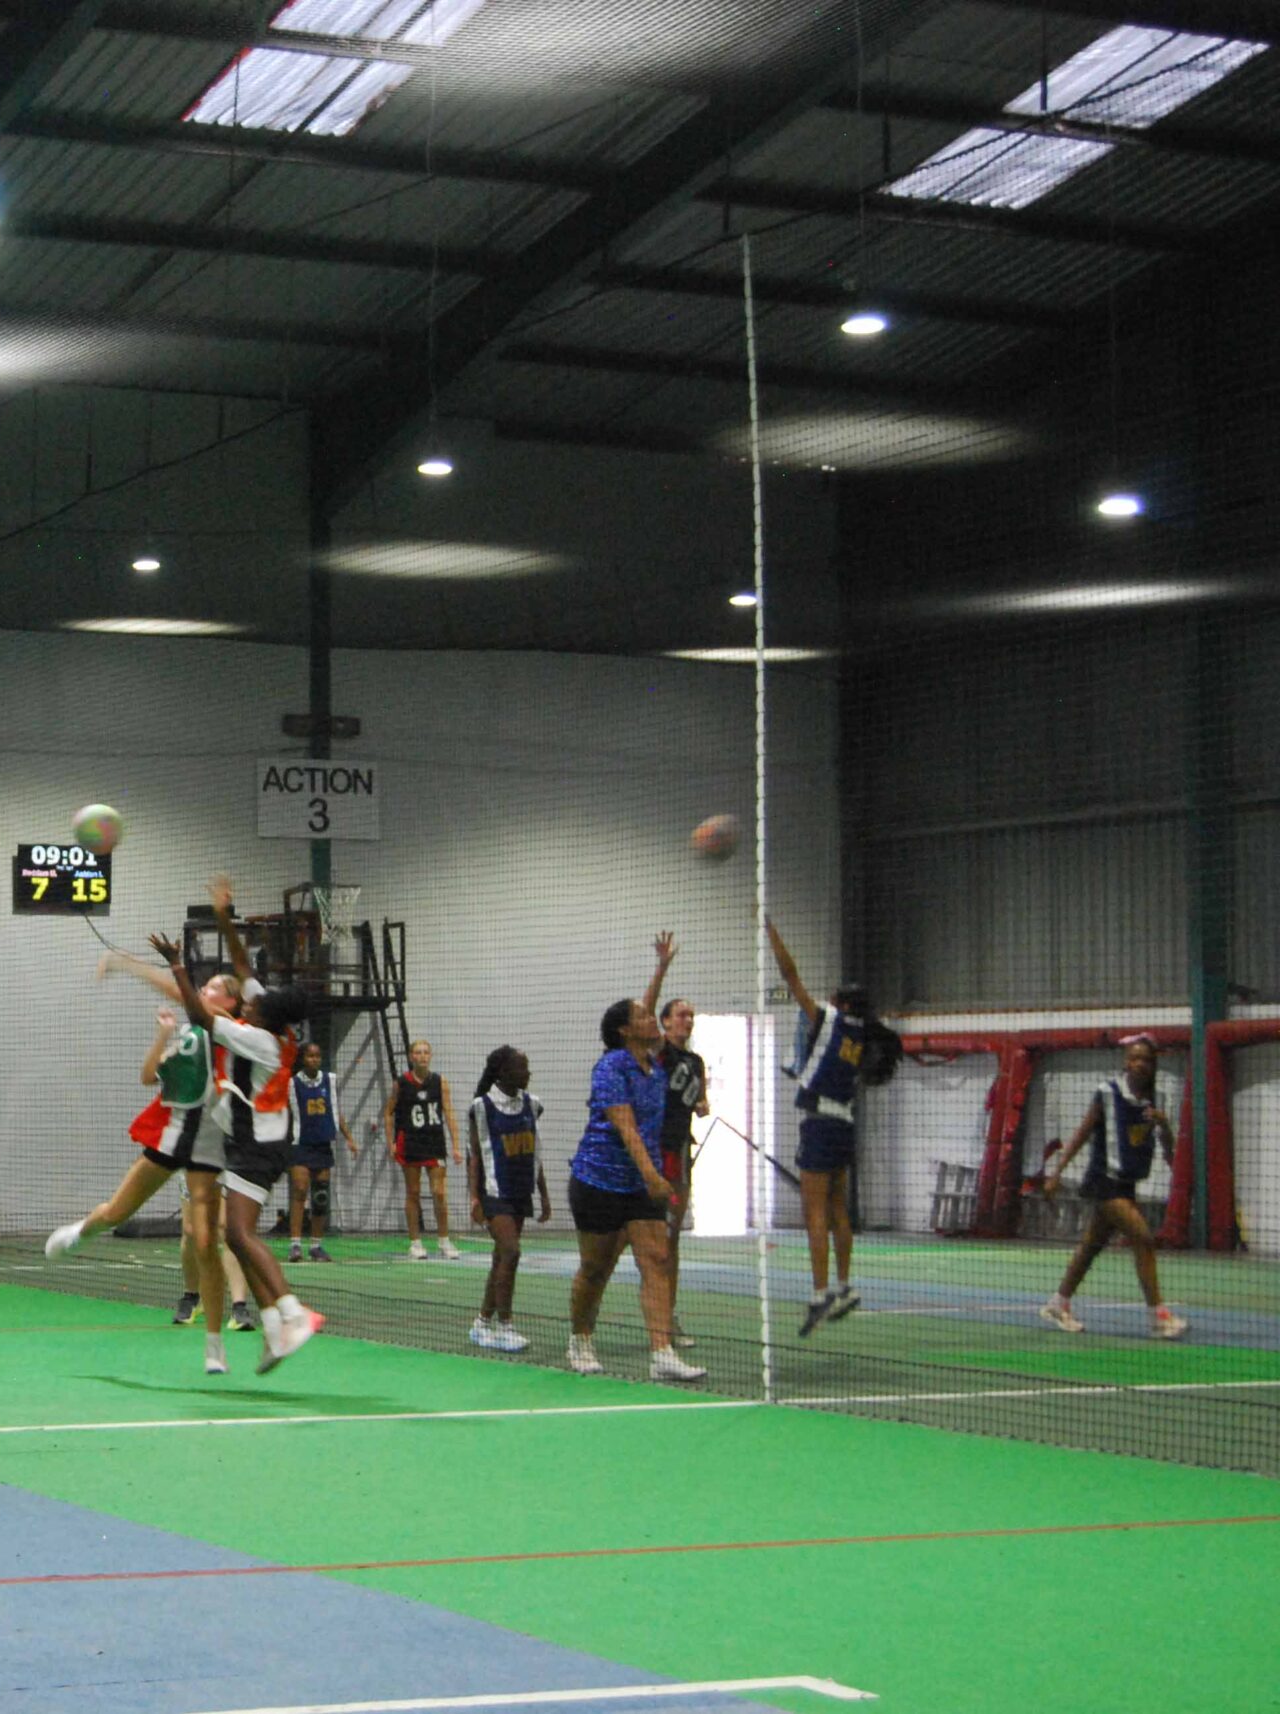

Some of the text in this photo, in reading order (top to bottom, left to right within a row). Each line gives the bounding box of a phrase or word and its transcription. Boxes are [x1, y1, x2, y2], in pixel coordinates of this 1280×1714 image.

[262, 766, 373, 795] ACTION
[308, 798, 331, 833] 3
[31, 845, 97, 867] 09:01
[31, 877, 49, 900] 7
[72, 878, 108, 902] 15
[411, 1102, 441, 1128] GK
